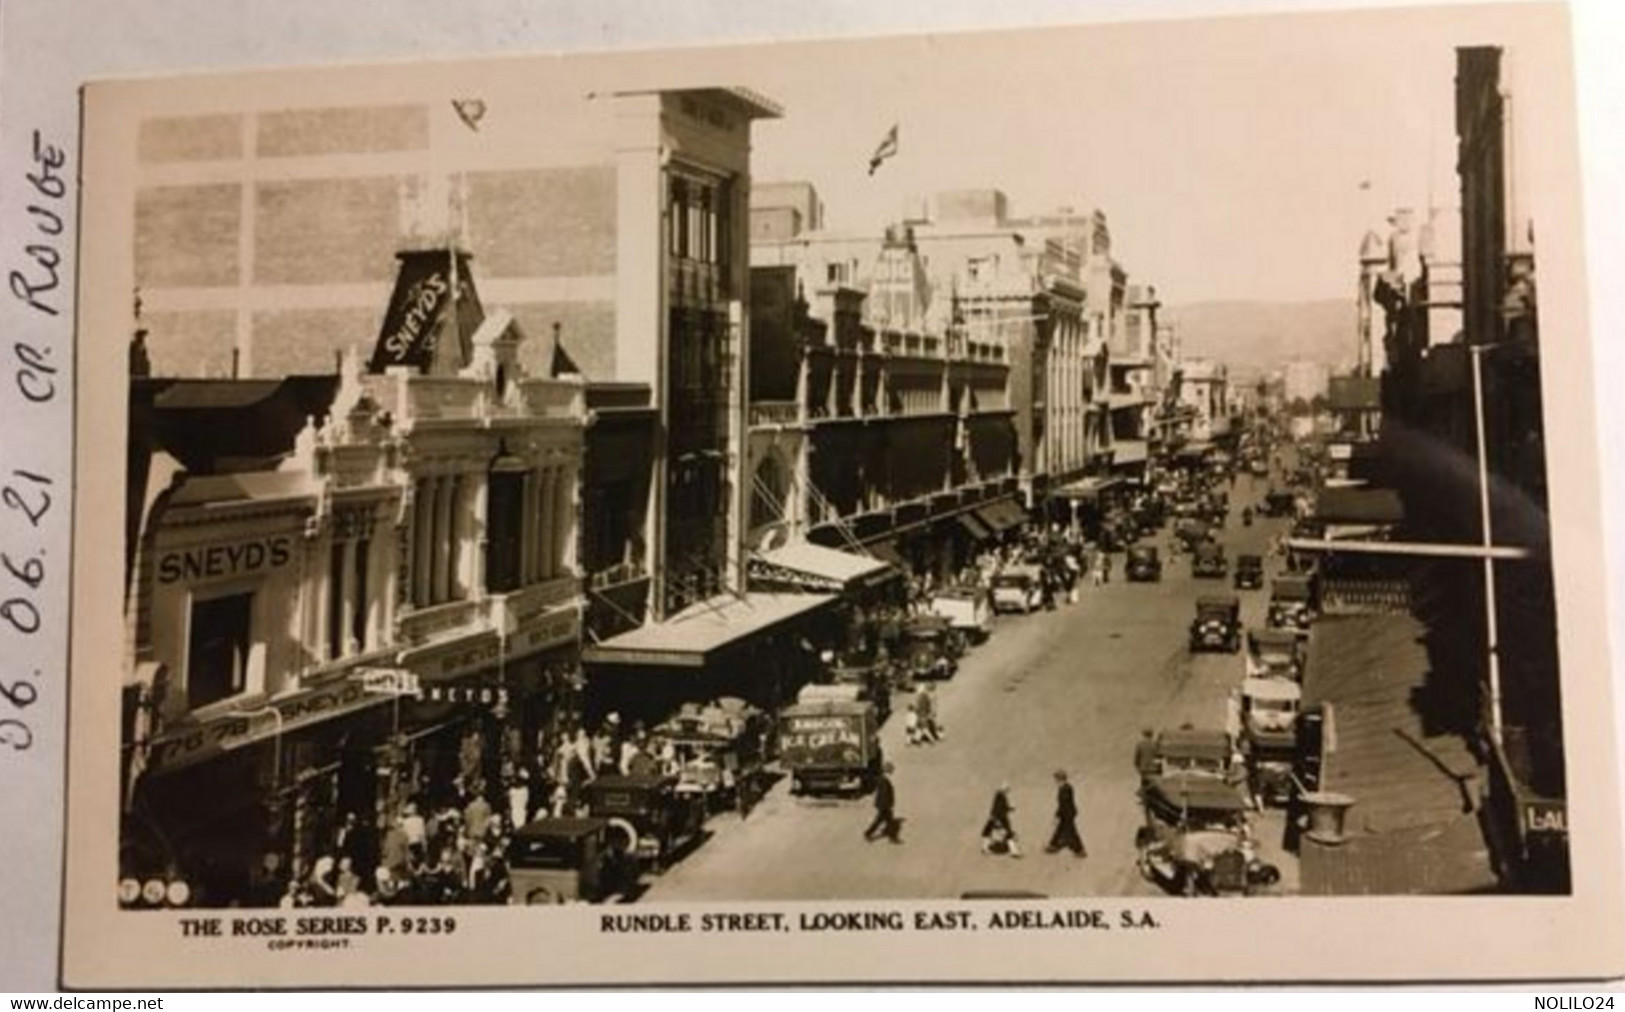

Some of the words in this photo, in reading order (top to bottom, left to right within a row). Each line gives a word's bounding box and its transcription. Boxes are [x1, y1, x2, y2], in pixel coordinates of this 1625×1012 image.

[158, 537, 291, 585] SNEYD'S
[179, 919, 222, 936] THE
[232, 918, 287, 936] ROSE
[295, 917, 367, 935] SERIES
[400, 917, 457, 934] 9239
[600, 913, 692, 932] RUNDLE
[701, 912, 790, 933] STREET,
[799, 911, 903, 931] LOOKING
[914, 911, 977, 931] EAST,
[988, 910, 1110, 930] ADELAIDE,
[1120, 909, 1161, 929] S.A.
